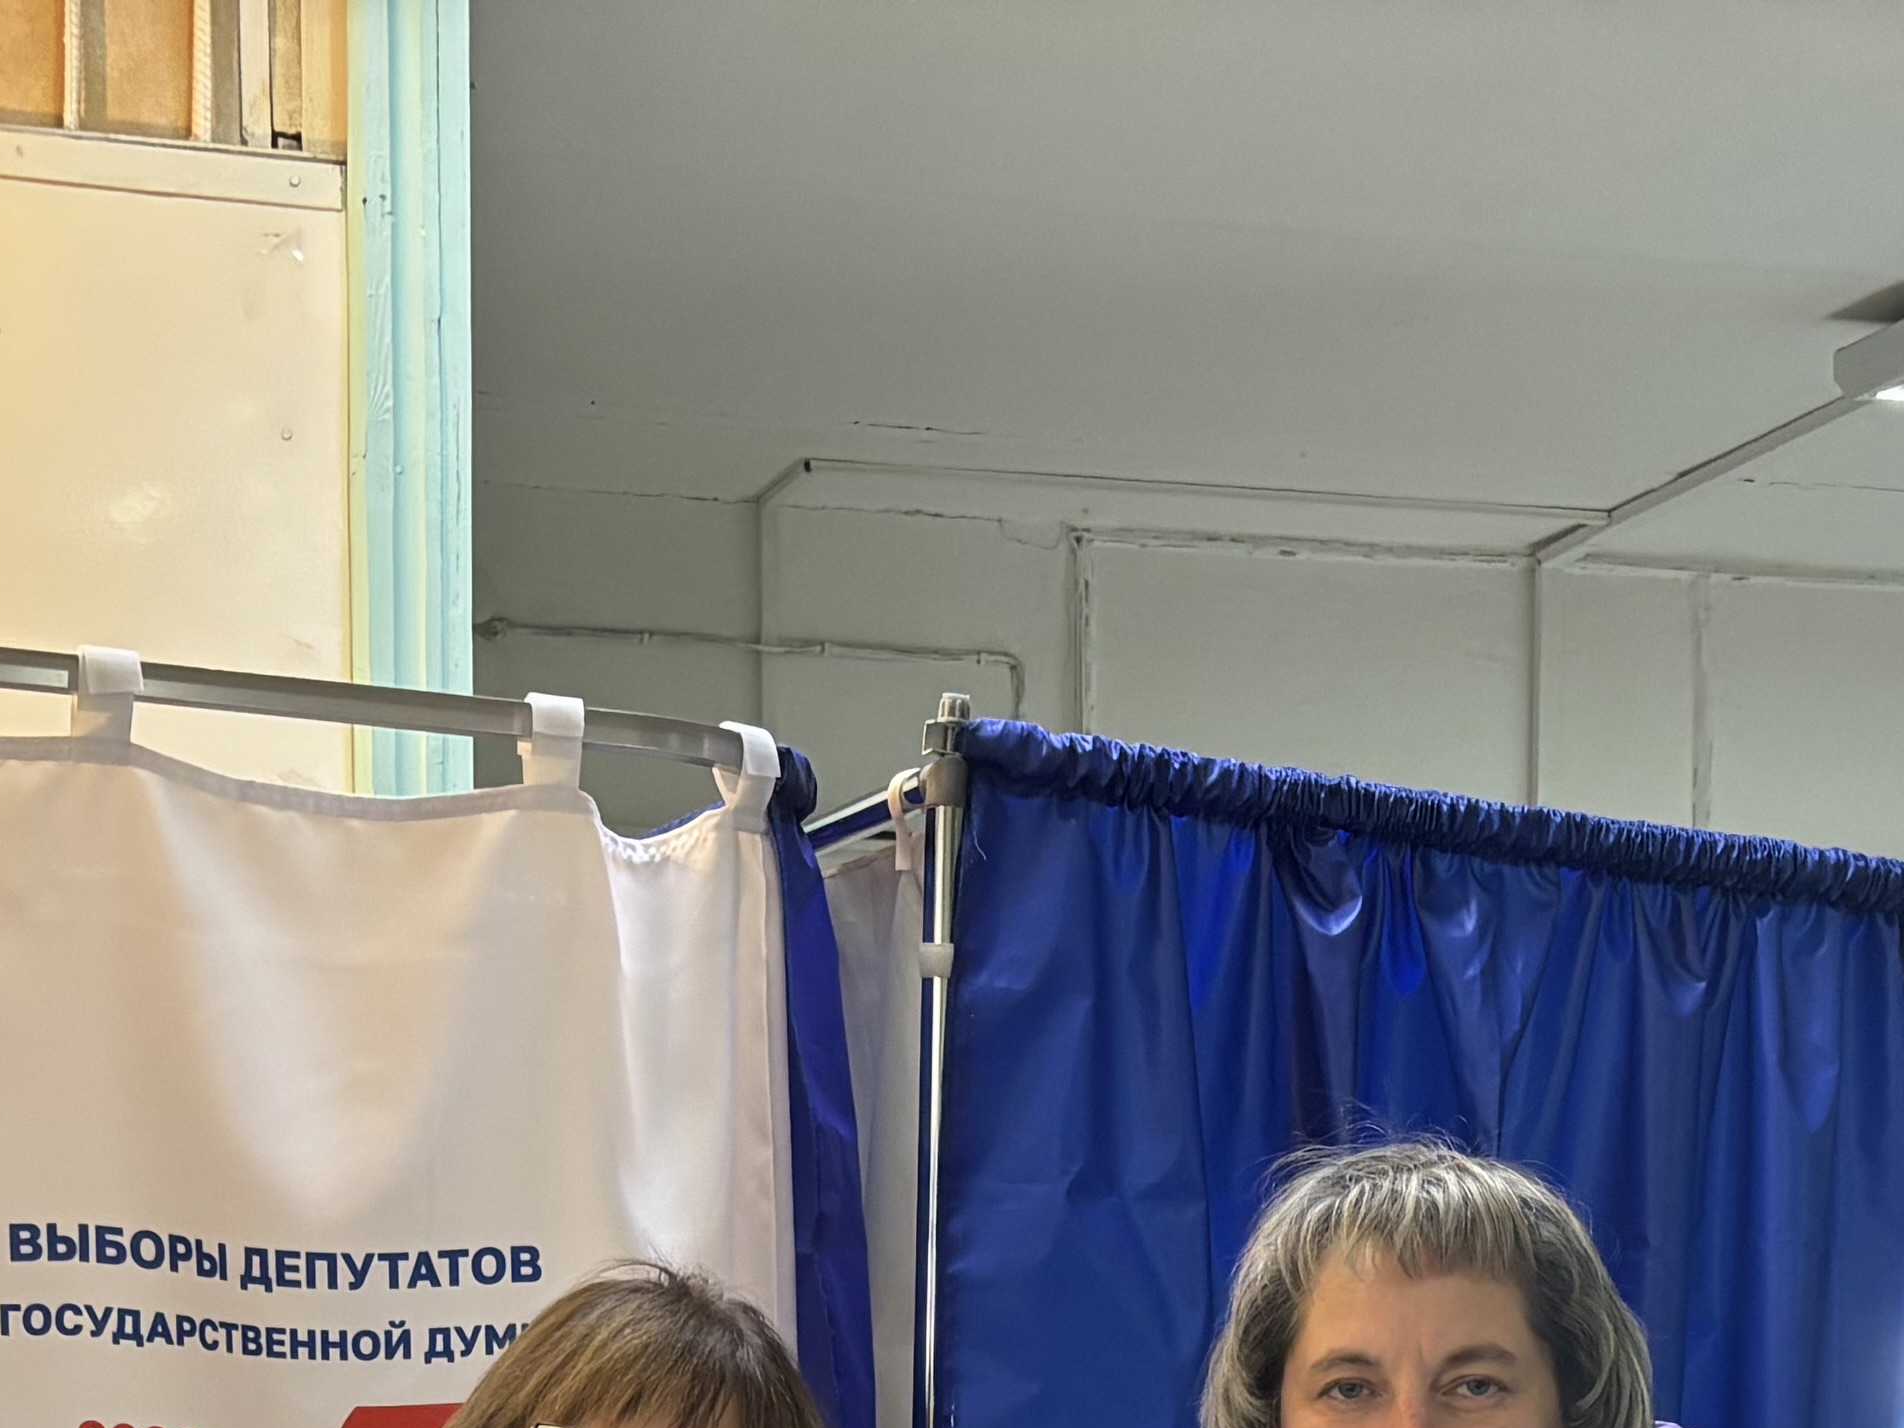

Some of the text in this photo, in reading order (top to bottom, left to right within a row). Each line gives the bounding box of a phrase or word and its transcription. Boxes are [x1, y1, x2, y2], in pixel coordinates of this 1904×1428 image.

[9, 1223, 541, 1293] ВЫБОРЫ ДЕПУТАТОВ
[0, 1304, 532, 1364] ГОСУДАРСТВЕННОЙ ДУМ
